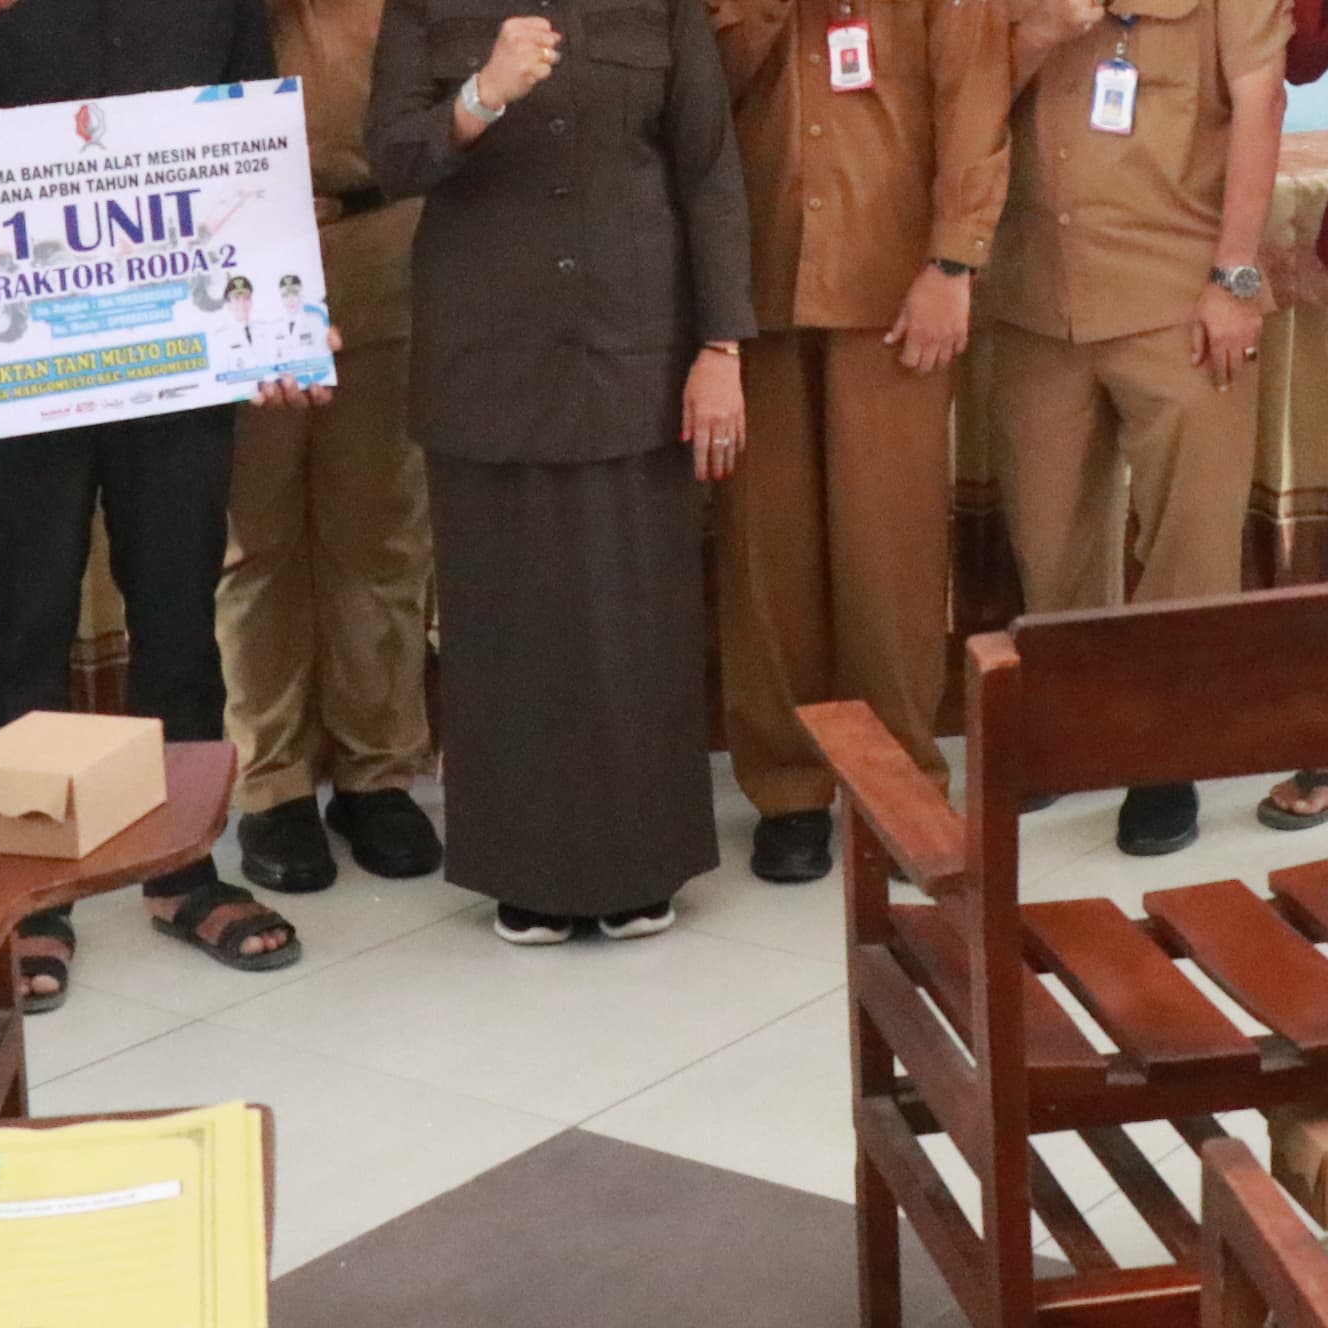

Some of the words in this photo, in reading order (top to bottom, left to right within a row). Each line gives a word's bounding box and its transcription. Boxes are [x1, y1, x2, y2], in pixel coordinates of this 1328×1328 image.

[20, 159, 97, 181] BANTUAN
[103, 153, 141, 170] ALAT
[147, 147, 196, 164] MESIN
[201, 135, 288, 158] PERTANIAN
[38, 181, 80, 199] APBN
[85, 174, 139, 192] TAHUN
[144, 162, 229, 185] ANGGARAN
[234, 156, 269, 174] 2026
[2, 211, 29, 259] 1
[63, 188, 199, 251] UNIT
[126, 249, 208, 281] RODA
[221, 245, 236, 267] 2
[53, 352, 96, 374] TANI
[101, 342, 161, 367] MULYO
[165, 336, 202, 357] DUA
